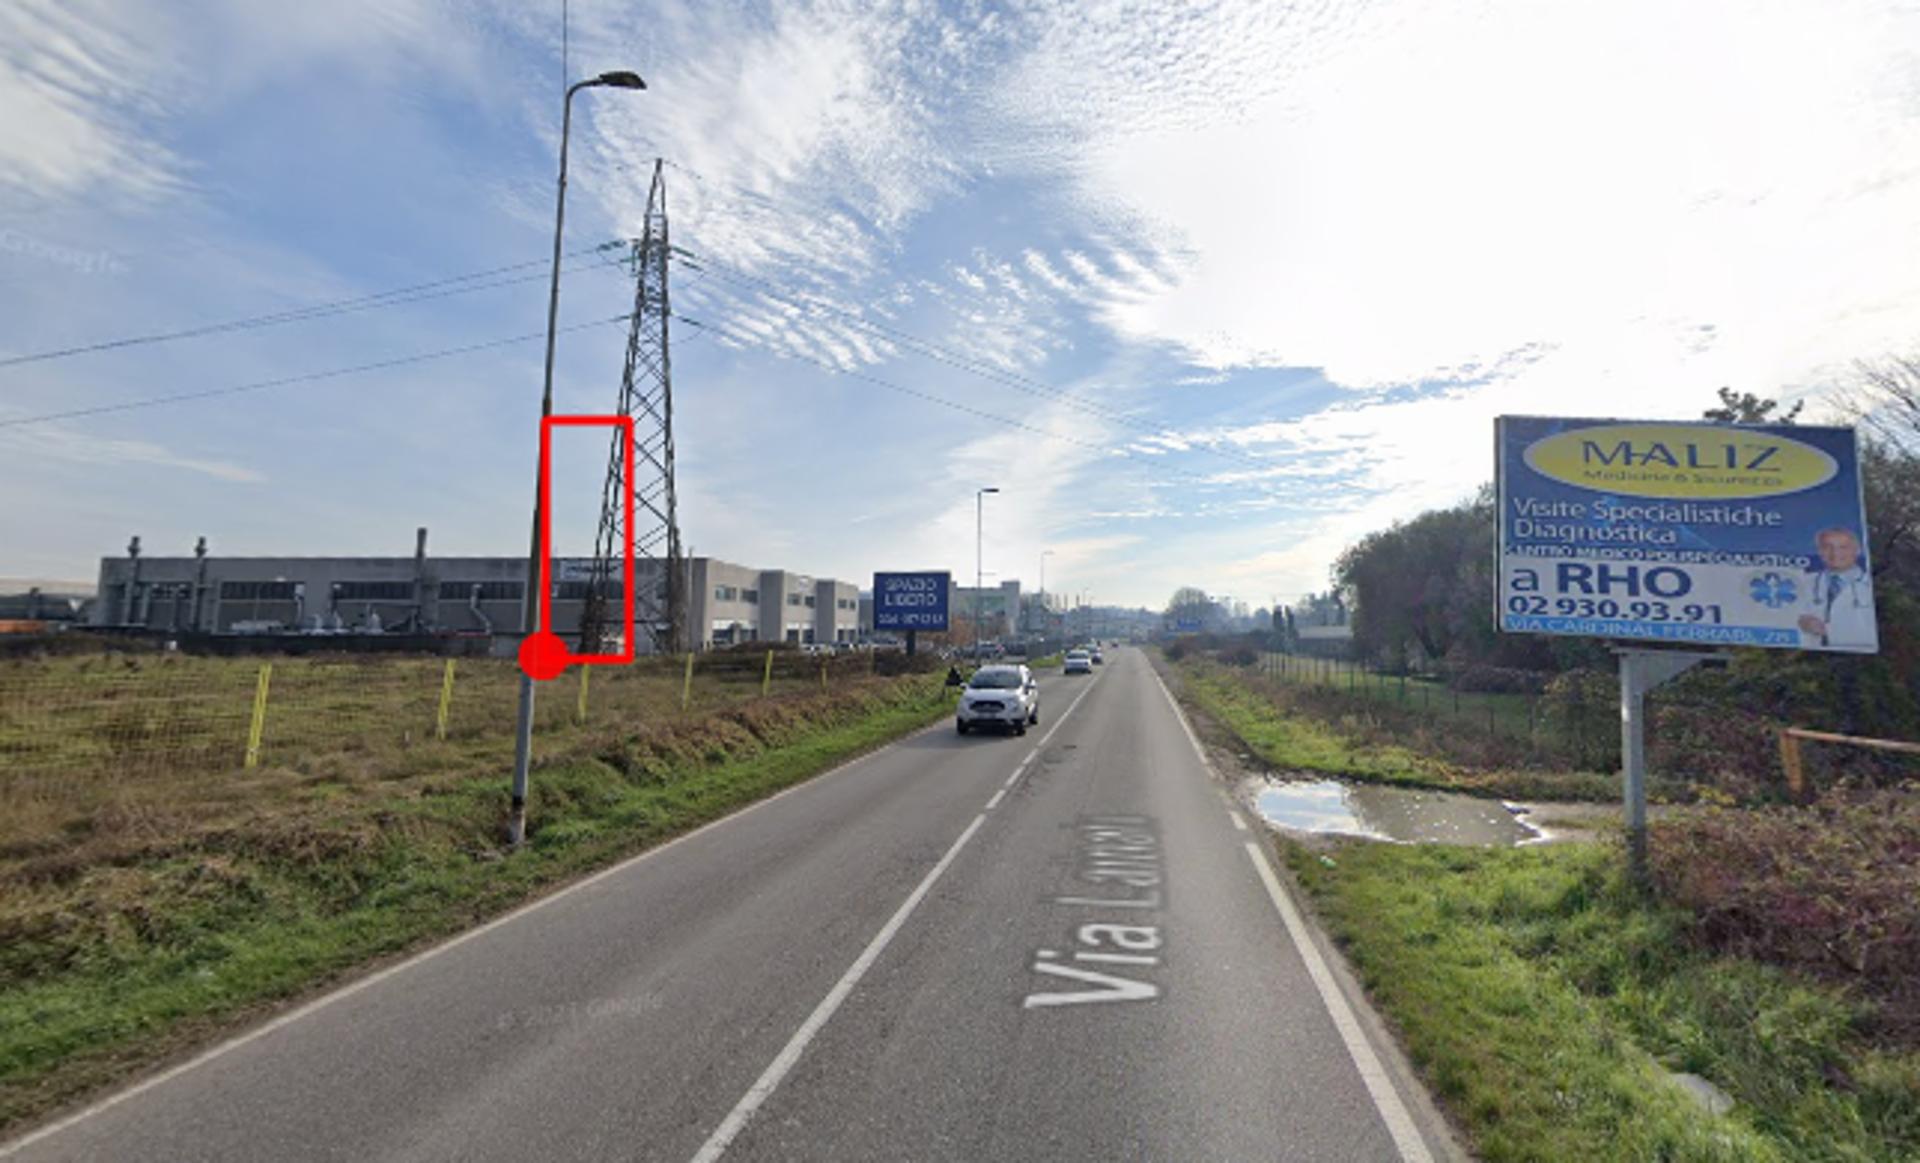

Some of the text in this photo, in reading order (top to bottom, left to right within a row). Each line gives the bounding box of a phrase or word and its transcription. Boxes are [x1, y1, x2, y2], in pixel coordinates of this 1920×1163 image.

[1580, 439, 1782, 472] MALIZ
[1513, 497, 1782, 526] Visite Specialistiche
[1514, 518, 1677, 543] Diagnostica
[1510, 562, 1692, 598] a RHO
[1508, 595, 1722, 624] 02 930.93.91
[1509, 617, 1544, 631] VIA
